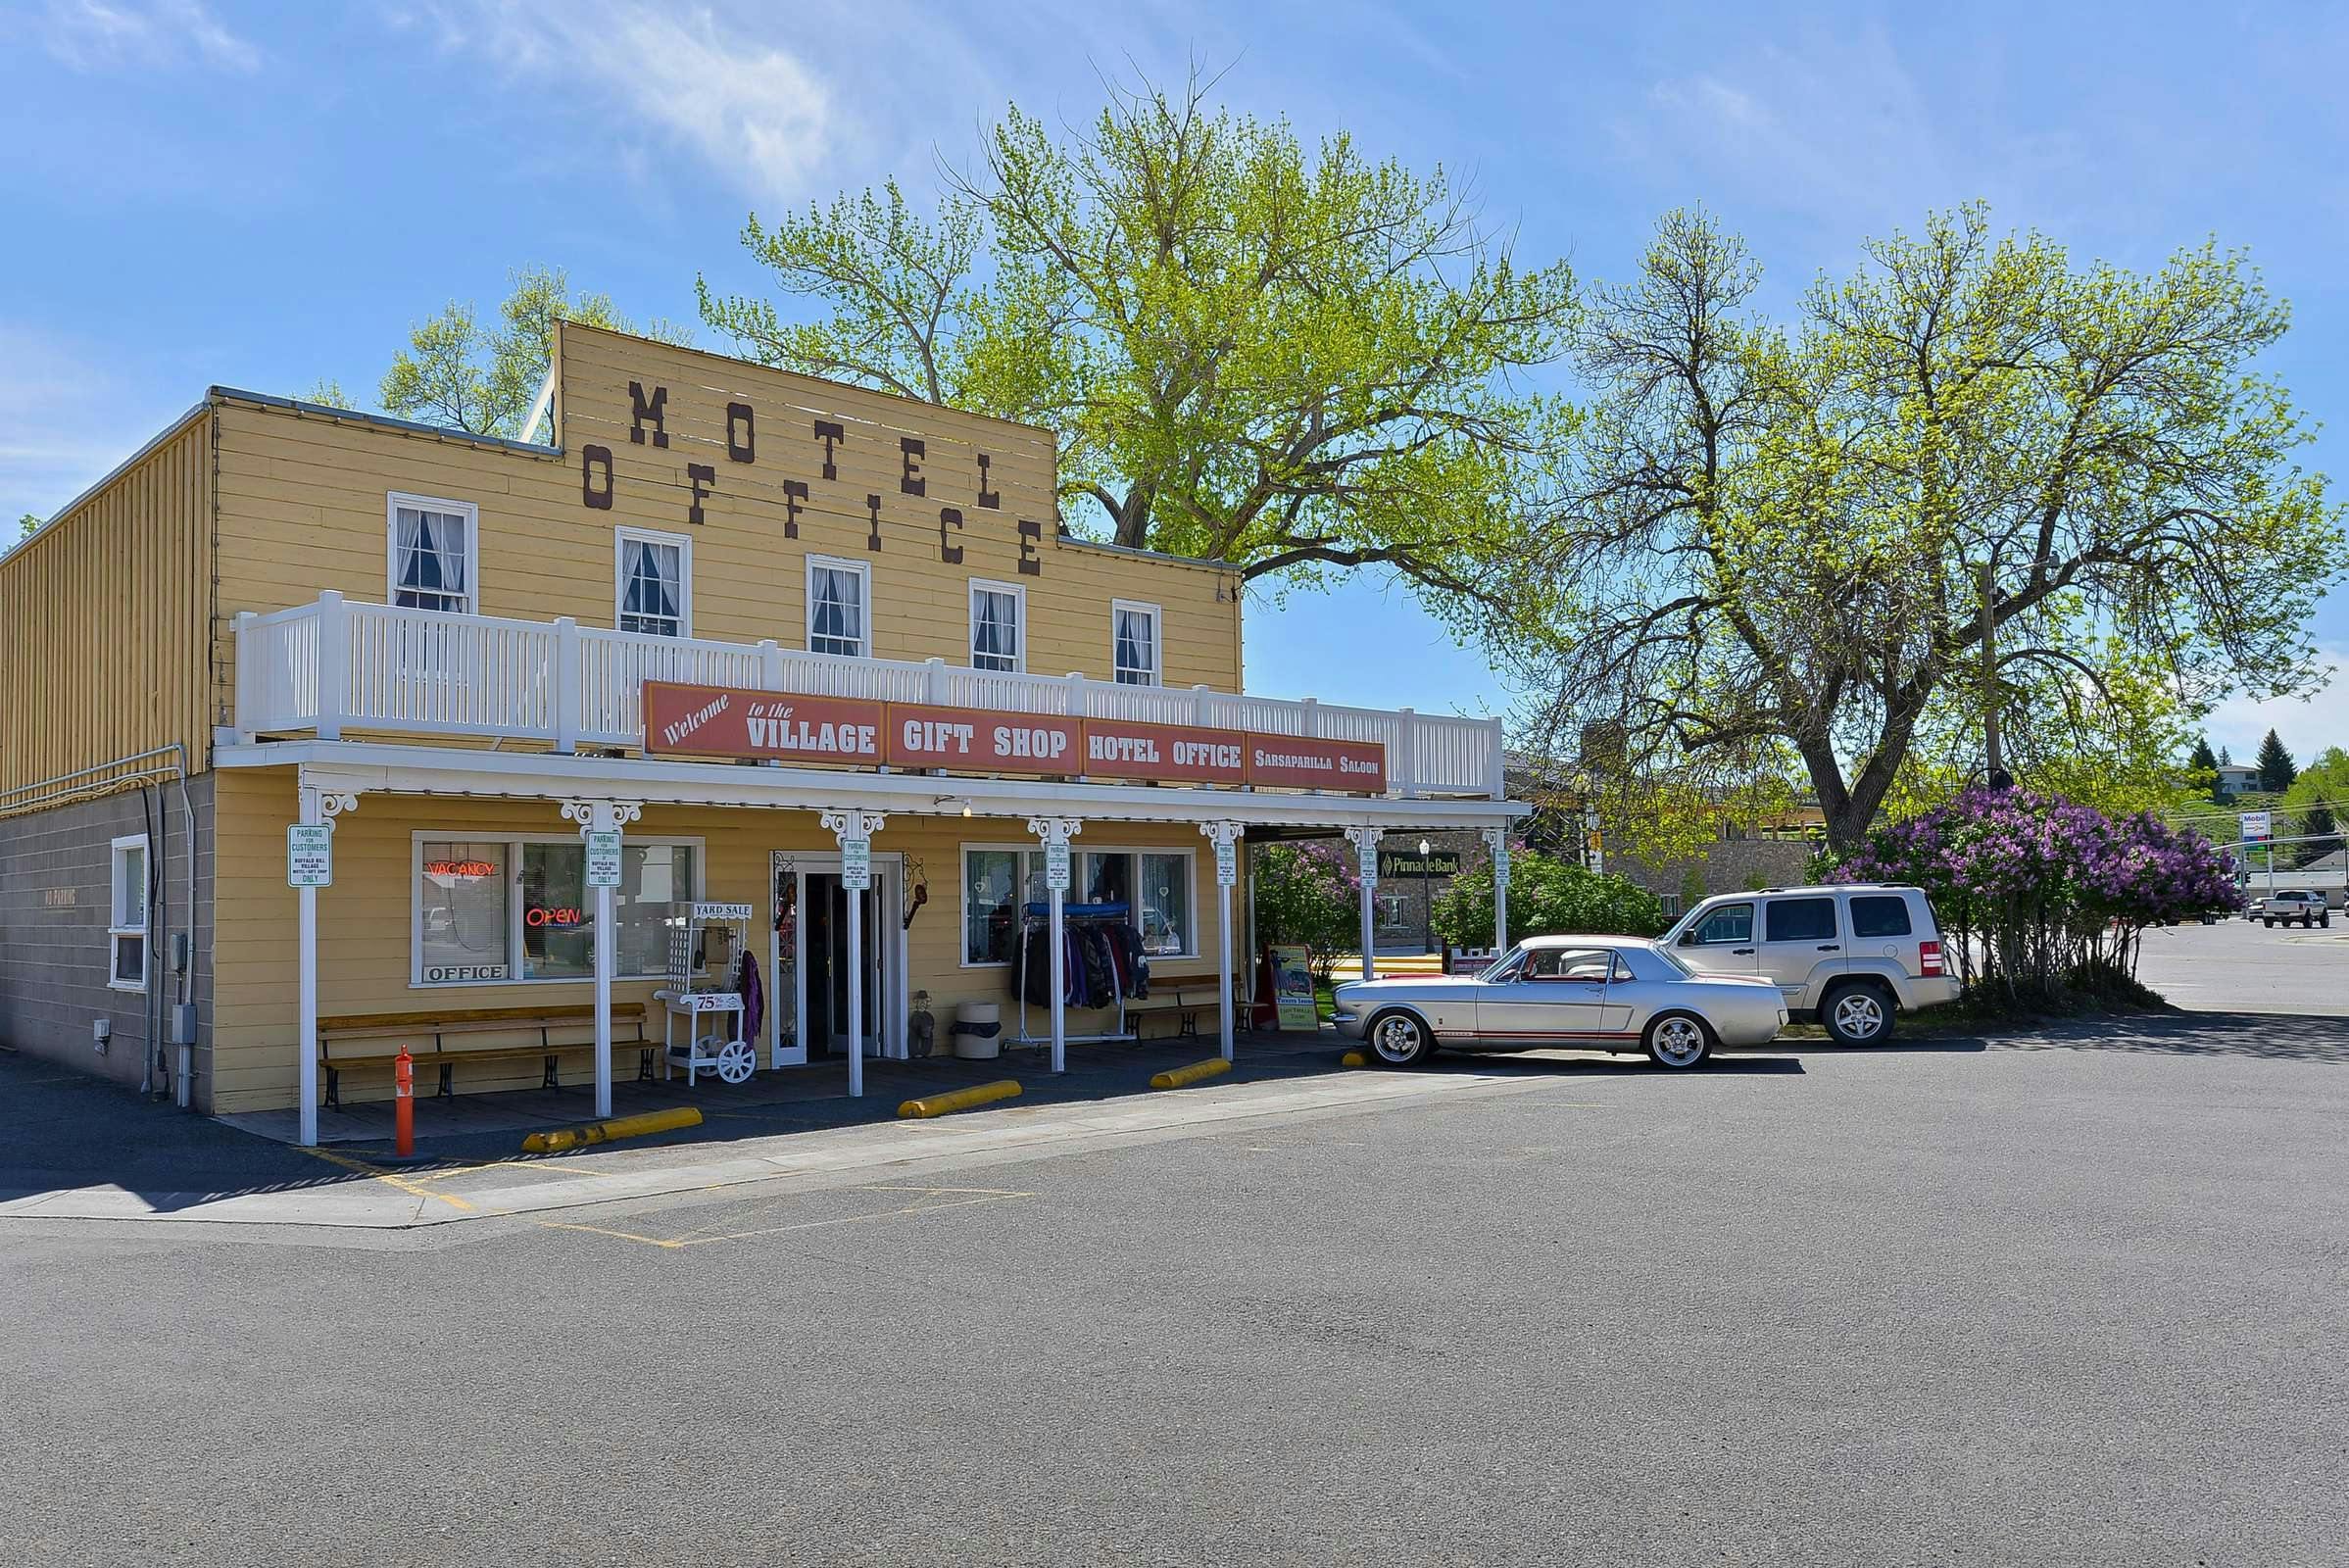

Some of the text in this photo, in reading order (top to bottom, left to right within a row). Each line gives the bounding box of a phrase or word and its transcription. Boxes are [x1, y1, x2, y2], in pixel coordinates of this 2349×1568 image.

[628, 380, 1000, 511] MOTEL
[582, 443, 1042, 576] OFFICE
[663, 693, 729, 746] Welcome
[747, 702, 793, 719] to the
[746, 717, 875, 754] VILLAGE
[903, 720, 1067, 760] GIFT SHOP
[1089, 735, 1242, 769] HOTEL OFFICE
[427, 862, 494, 877] VACANCY
[1394, 857, 1458, 872] Pinnacle Bank
[526, 907, 581, 926] OPEN
[697, 905, 750, 915] YARD SALE
[428, 966, 503, 980] OFFICE
